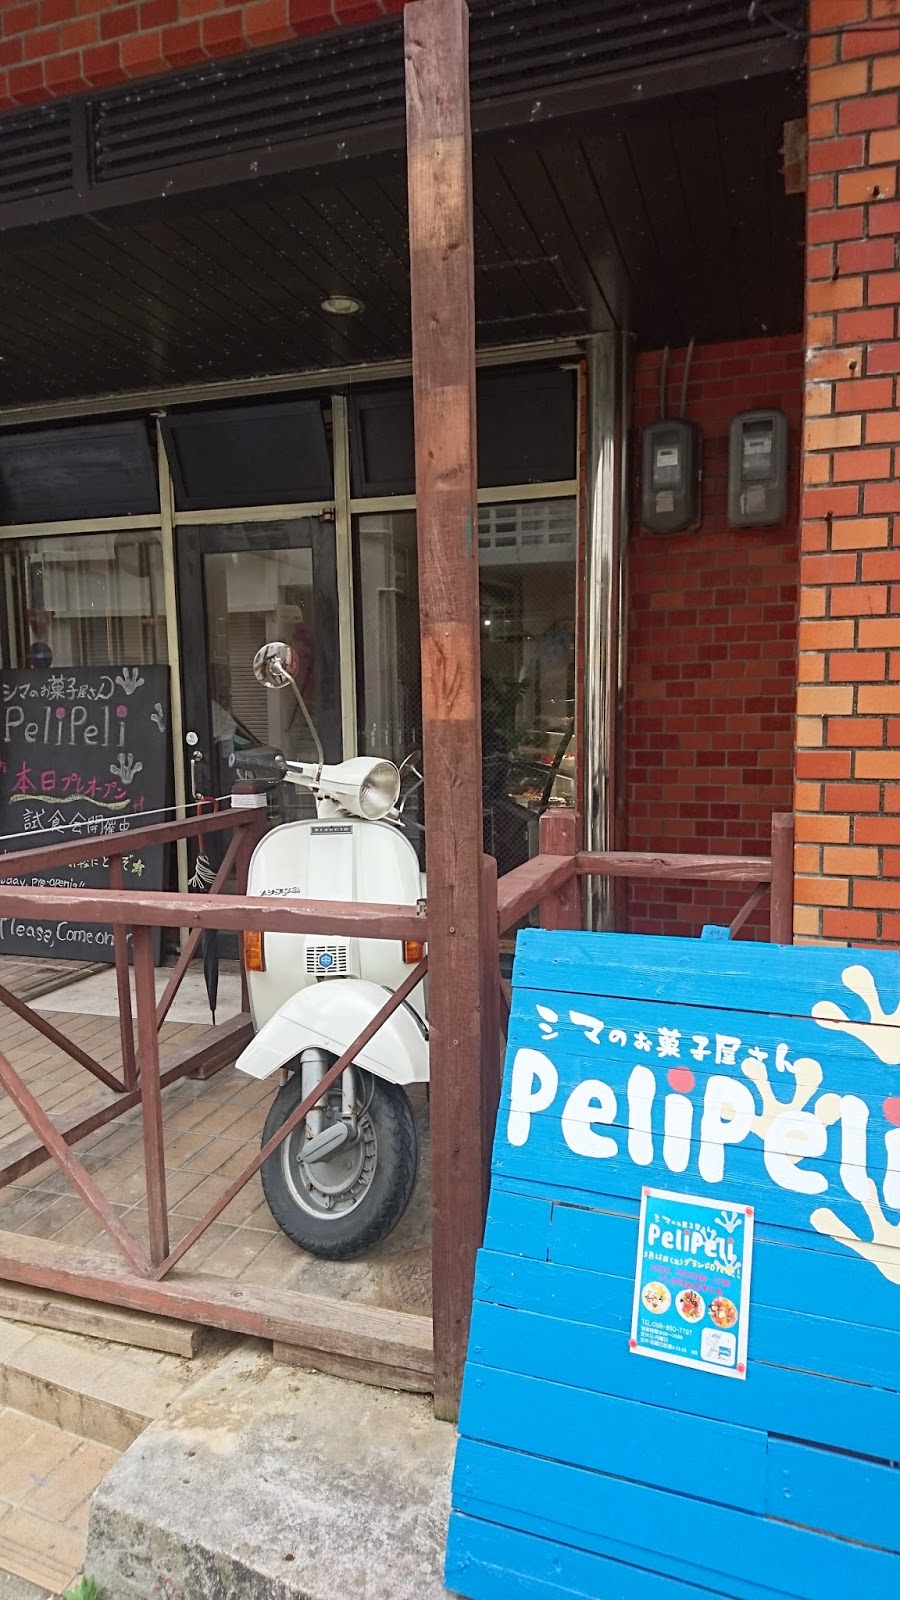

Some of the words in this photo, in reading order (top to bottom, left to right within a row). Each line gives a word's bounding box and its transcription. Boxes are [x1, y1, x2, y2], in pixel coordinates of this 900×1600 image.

[4, 705, 128, 747] PeliPeli
[536, 1003, 800, 1075] シマのお菓子屋さん
[507, 1048, 900, 1209] PeliPeli
[648, 1222, 734, 1261] PeliPeli
